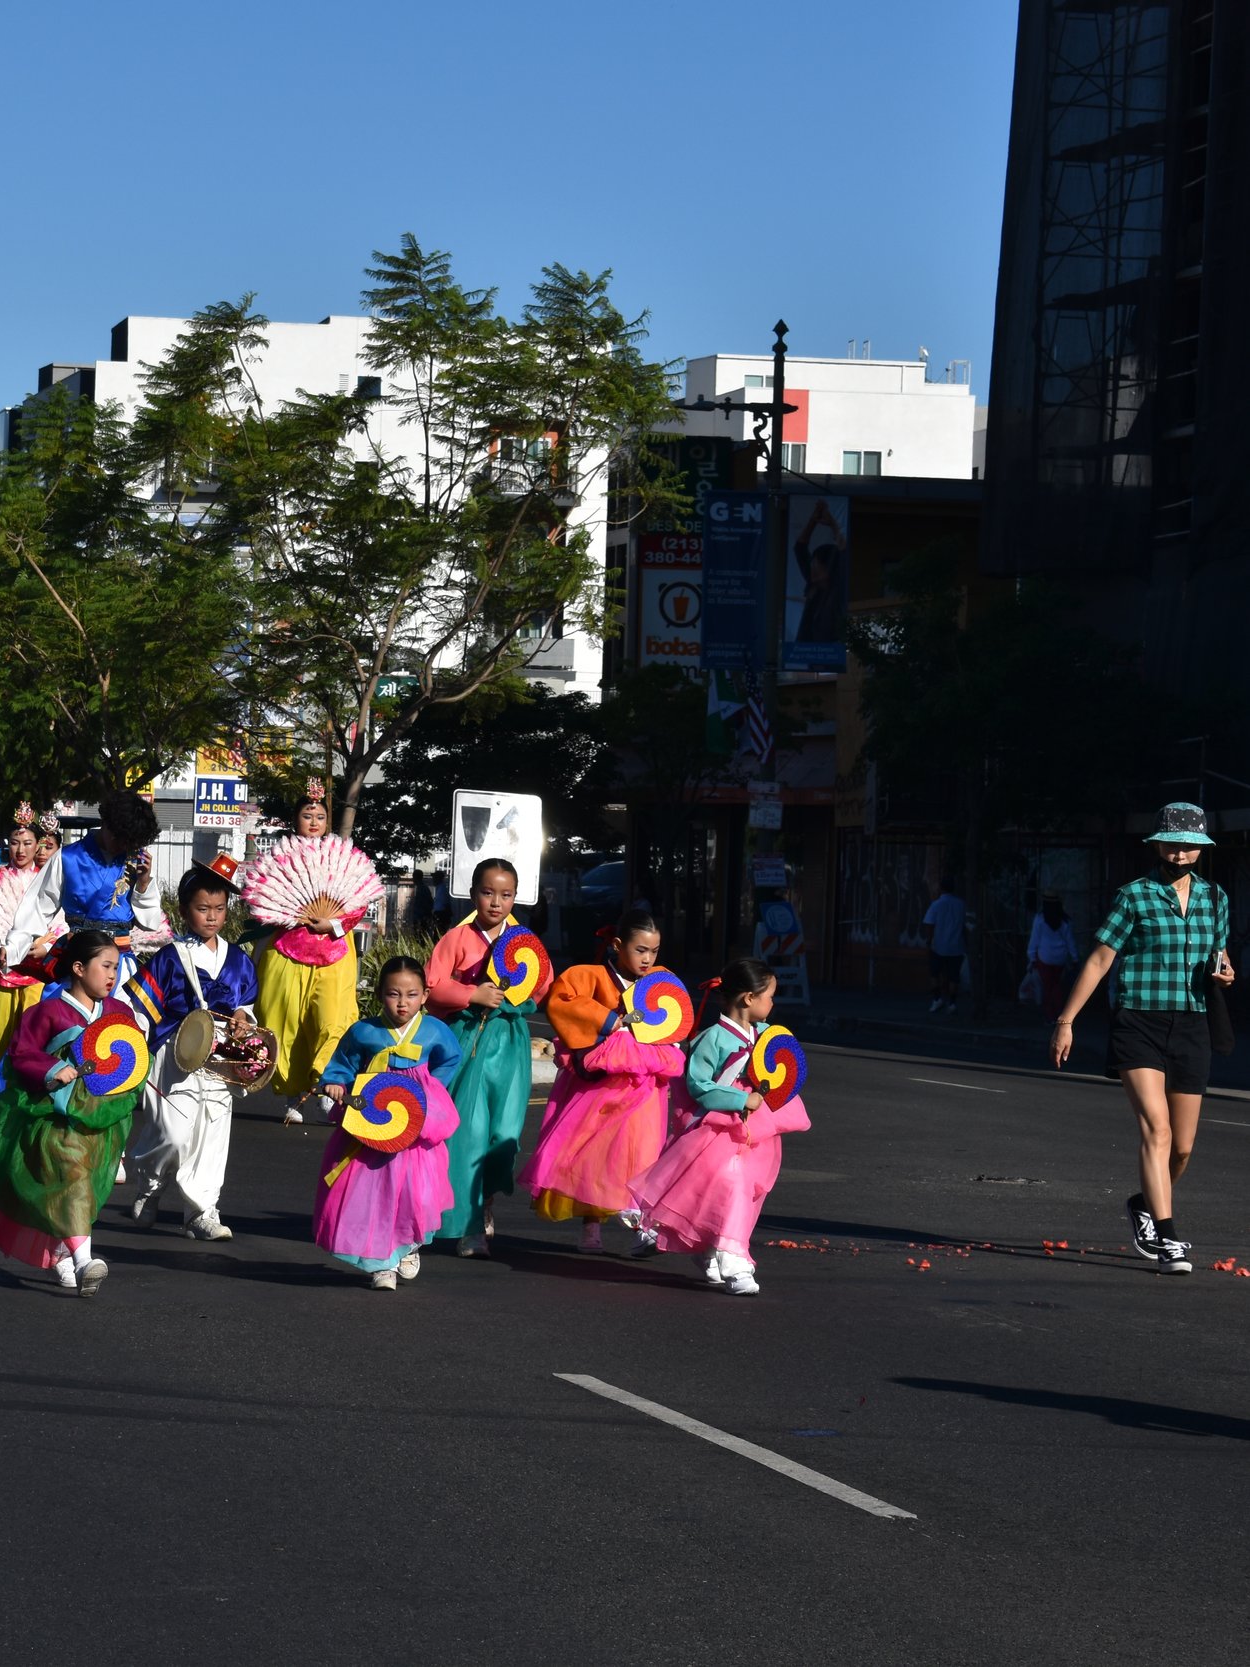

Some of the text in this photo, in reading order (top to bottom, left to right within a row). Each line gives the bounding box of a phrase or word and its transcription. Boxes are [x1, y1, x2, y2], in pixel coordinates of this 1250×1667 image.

[646, 636, 700, 655] boba
[198, 782, 227, 801] J.H.
[199, 803, 210, 812] JH
[198, 815, 225, 826] (213)
